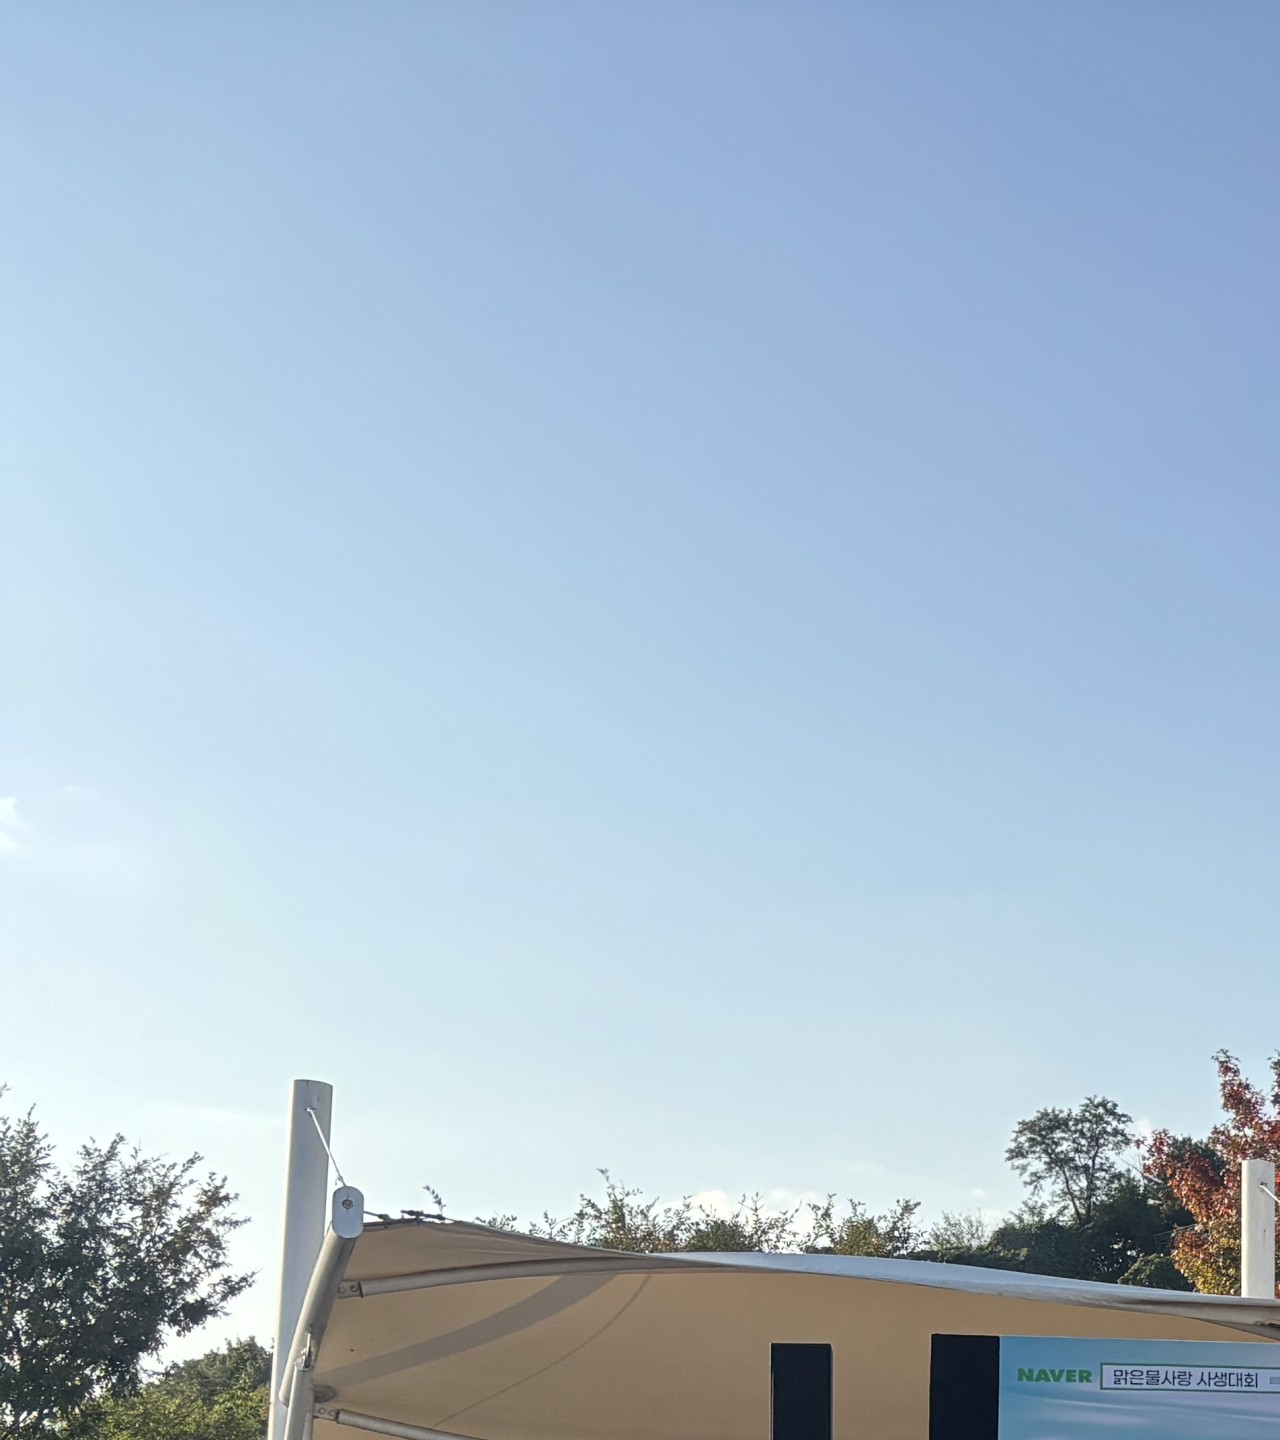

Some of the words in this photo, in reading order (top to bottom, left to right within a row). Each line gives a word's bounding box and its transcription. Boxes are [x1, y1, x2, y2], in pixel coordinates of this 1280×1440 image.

[1017, 1367, 1093, 1384] NAVER
[1113, 1369, 1193, 1386] 맑은물사랑
[1196, 1371, 1259, 1389] 사생대회
